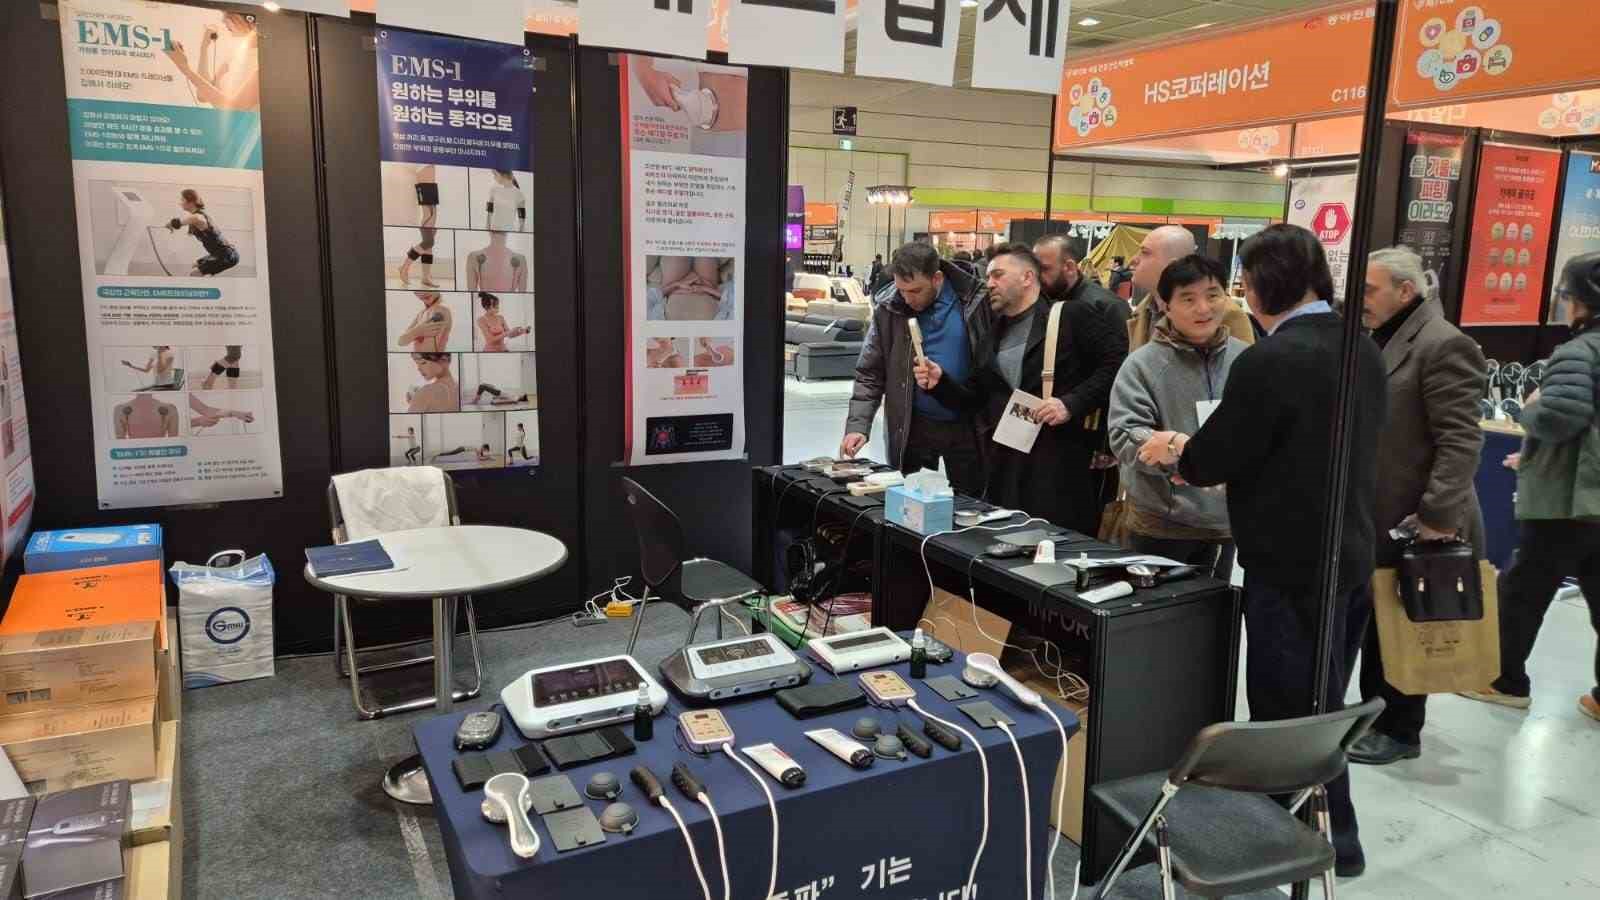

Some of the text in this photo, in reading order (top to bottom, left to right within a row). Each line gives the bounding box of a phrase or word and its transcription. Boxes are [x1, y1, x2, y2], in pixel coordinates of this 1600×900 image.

[78, 20, 174, 52] EMS-1
[390, 54, 463, 81] EMS-1
[392, 81, 496, 109] 원하는 부위를
[1144, 60, 1270, 104] HS코퍼레이션
[1331, 86, 1367, 103] C116
[392, 104, 512, 132] 원하는 동작으로
[861, 856, 912, 890] 기는
